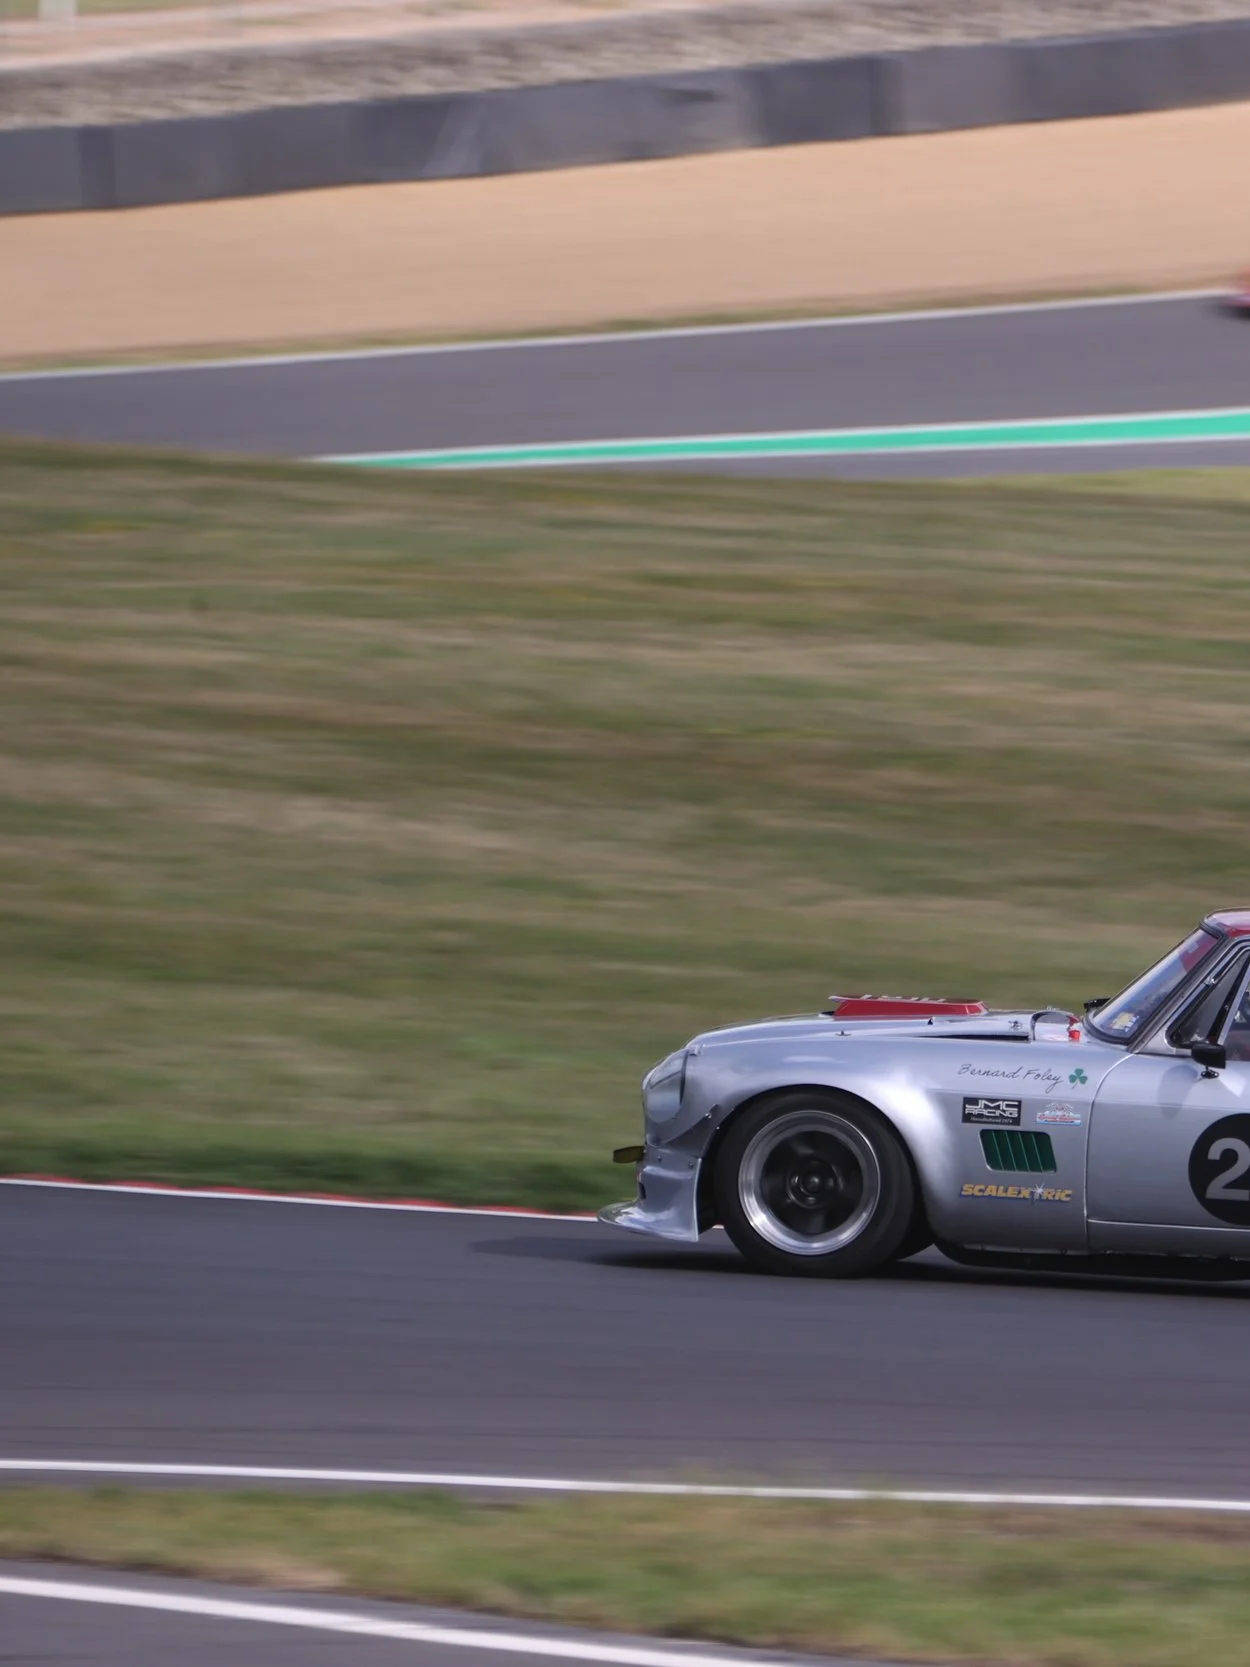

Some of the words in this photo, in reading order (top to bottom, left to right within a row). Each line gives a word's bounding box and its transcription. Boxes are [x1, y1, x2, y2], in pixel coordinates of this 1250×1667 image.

[958, 1063, 1022, 1079] Bernard
[1023, 1068, 1064, 1094] Foley
[965, 1099, 1018, 1110] JMC
[965, 1108, 1018, 1118] RACING
